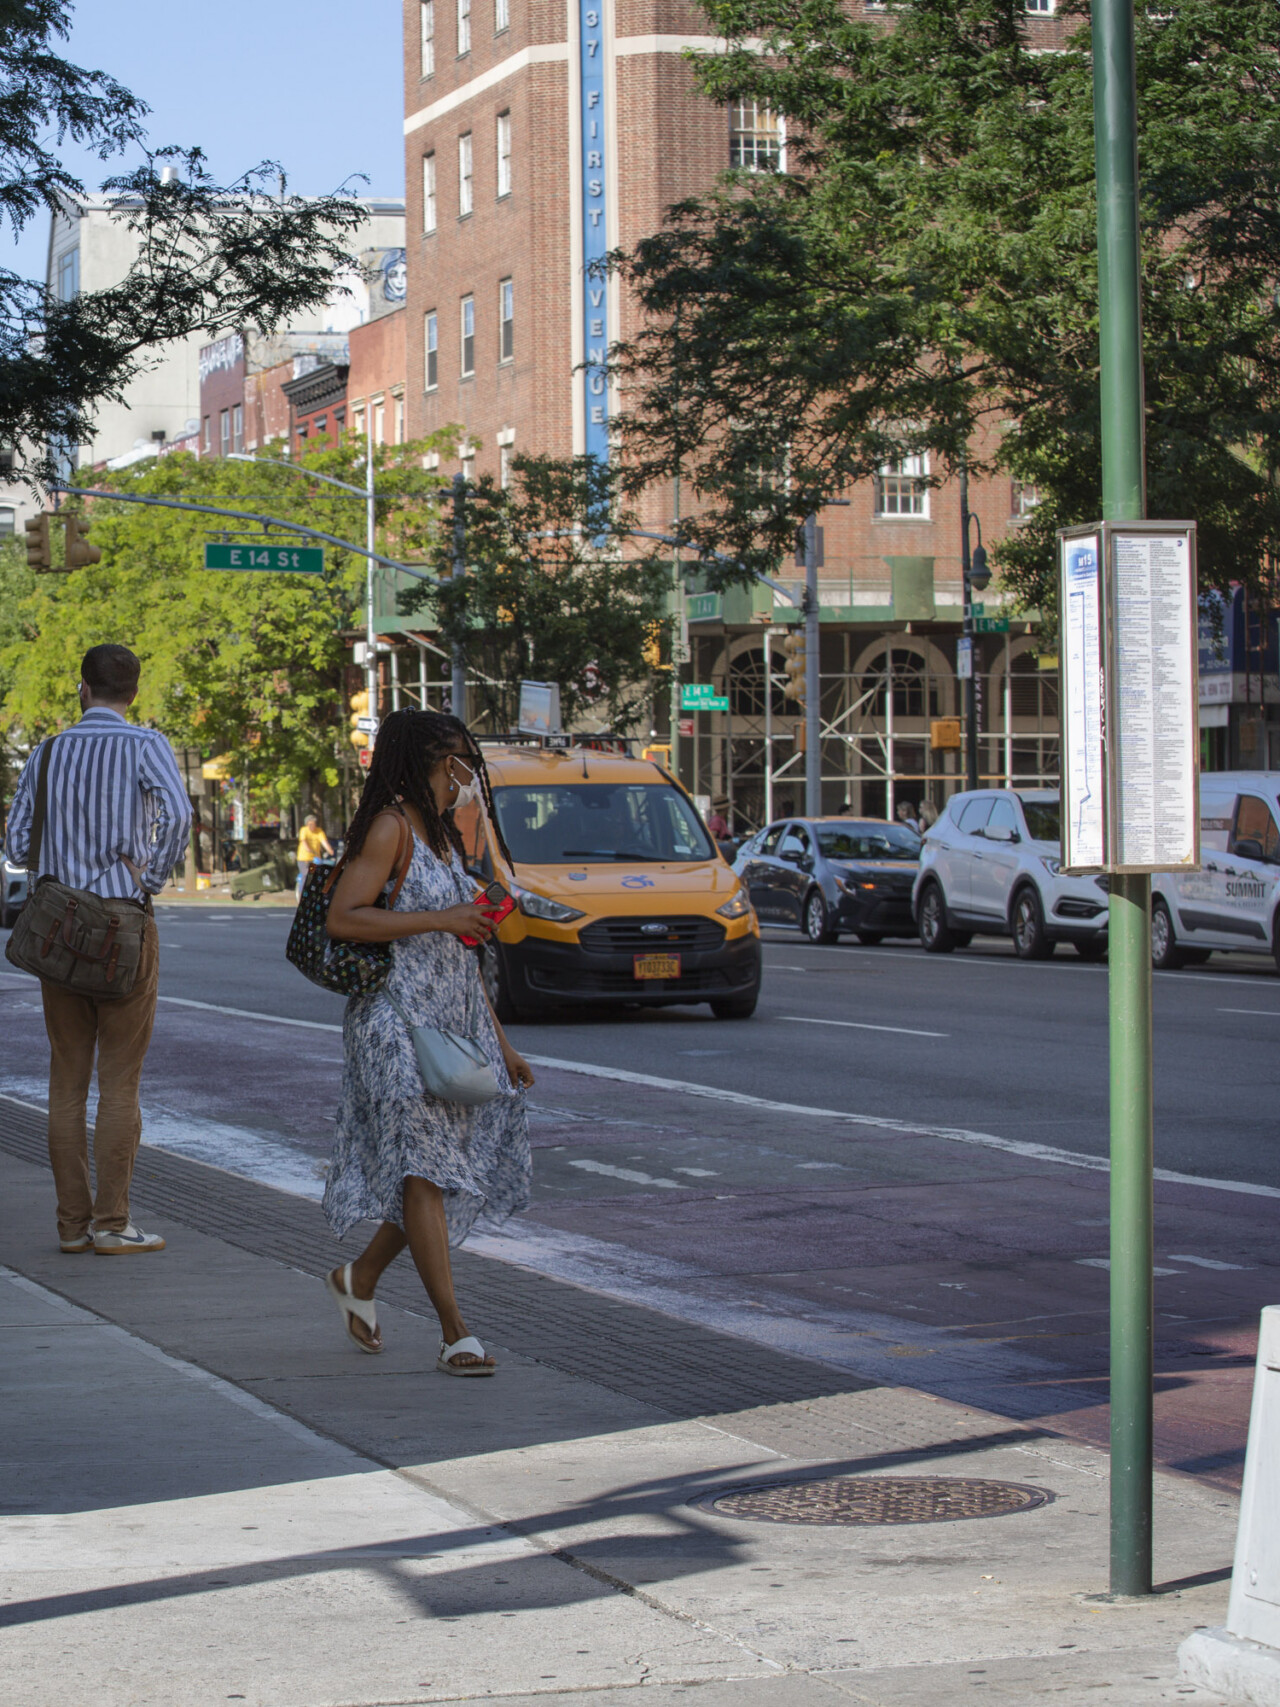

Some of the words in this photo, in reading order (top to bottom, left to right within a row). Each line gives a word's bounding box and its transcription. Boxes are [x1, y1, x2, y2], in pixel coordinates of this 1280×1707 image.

[585, 10, 599, 57] 37
[587, 91, 603, 227] FIRST
[230, 550, 242, 565] E
[249, 550, 271, 566] 14
[277, 551, 300, 568] St
[693, 686, 701, 696] 14
[1225, 882, 1265, 897] SUMMIT
